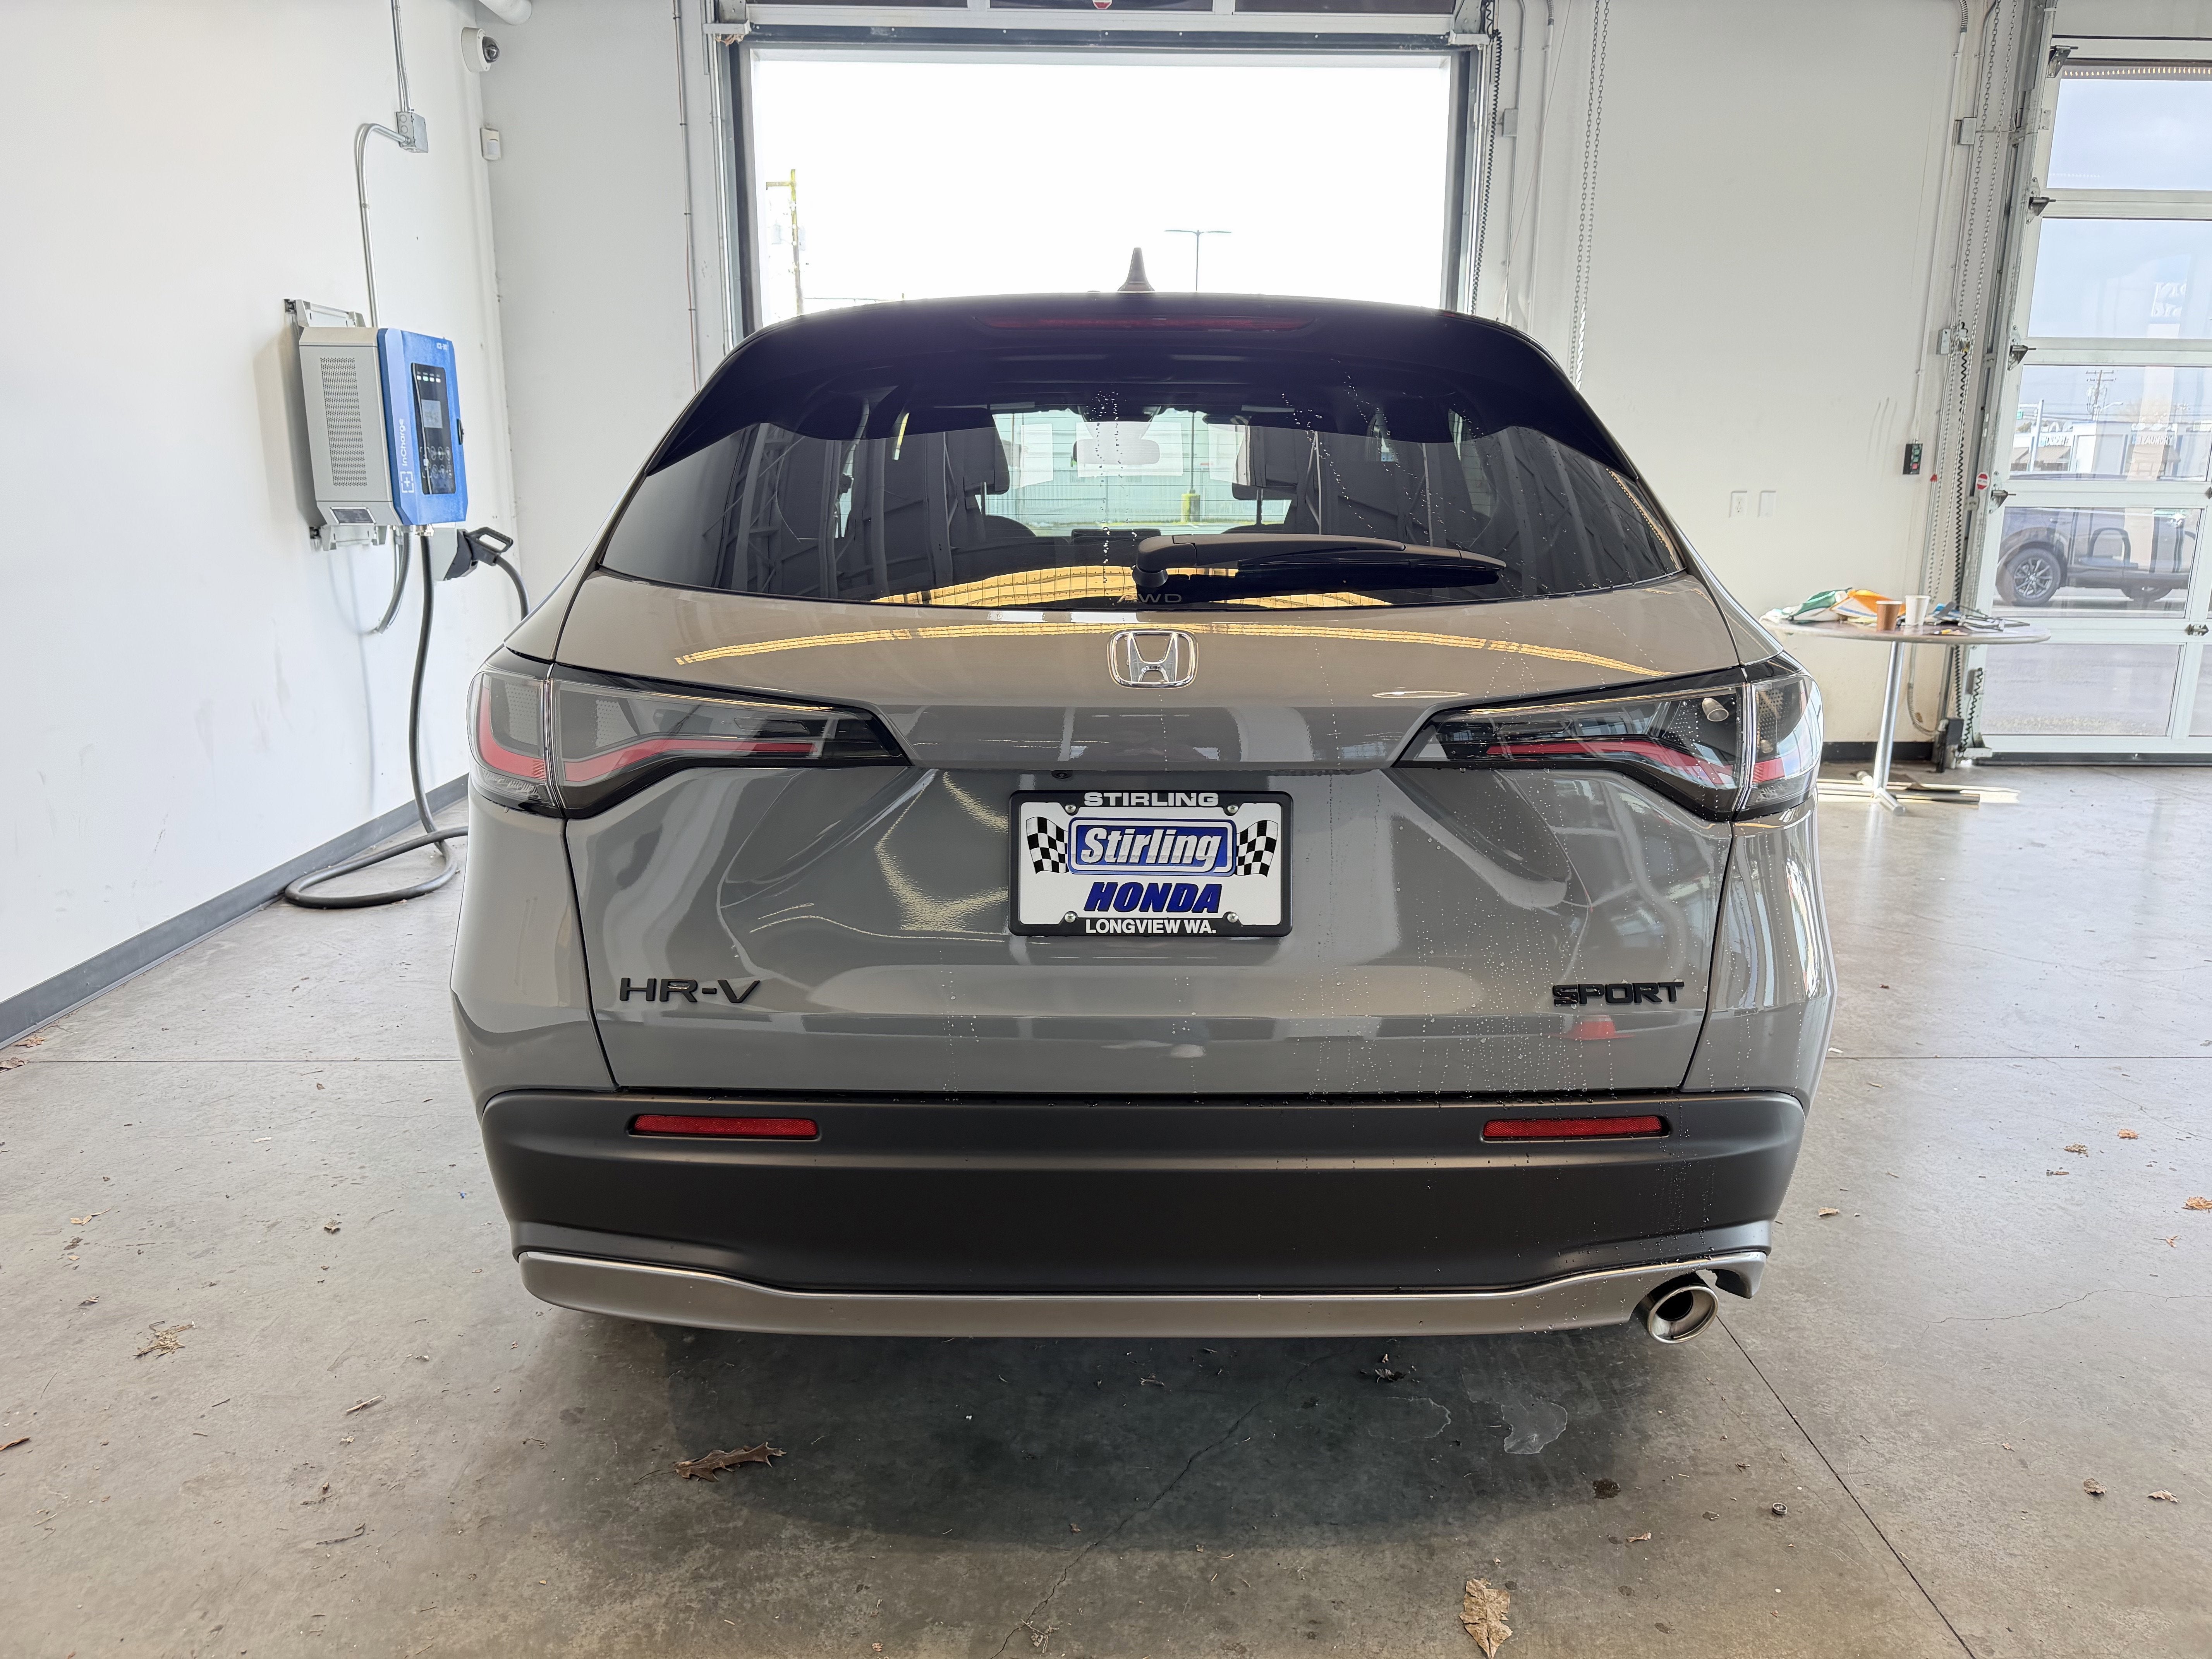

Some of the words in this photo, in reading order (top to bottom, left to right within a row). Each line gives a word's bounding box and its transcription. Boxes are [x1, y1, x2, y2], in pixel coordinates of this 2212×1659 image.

[399, 418, 408, 466] InCharge
[2141, 435, 2173, 445] LAUNDRY
[1117, 593, 1182, 603] AWD
[1084, 792, 1219, 806] STIRLING
[1081, 828, 1222, 872] Stirling
[1083, 882, 1222, 913] HONDA
[1085, 919, 1181, 934] LONGVIEW
[1184, 919, 1217, 934] WA.
[620, 977, 761, 1003] HR-V
[1552, 981, 1685, 1005] SPORT
